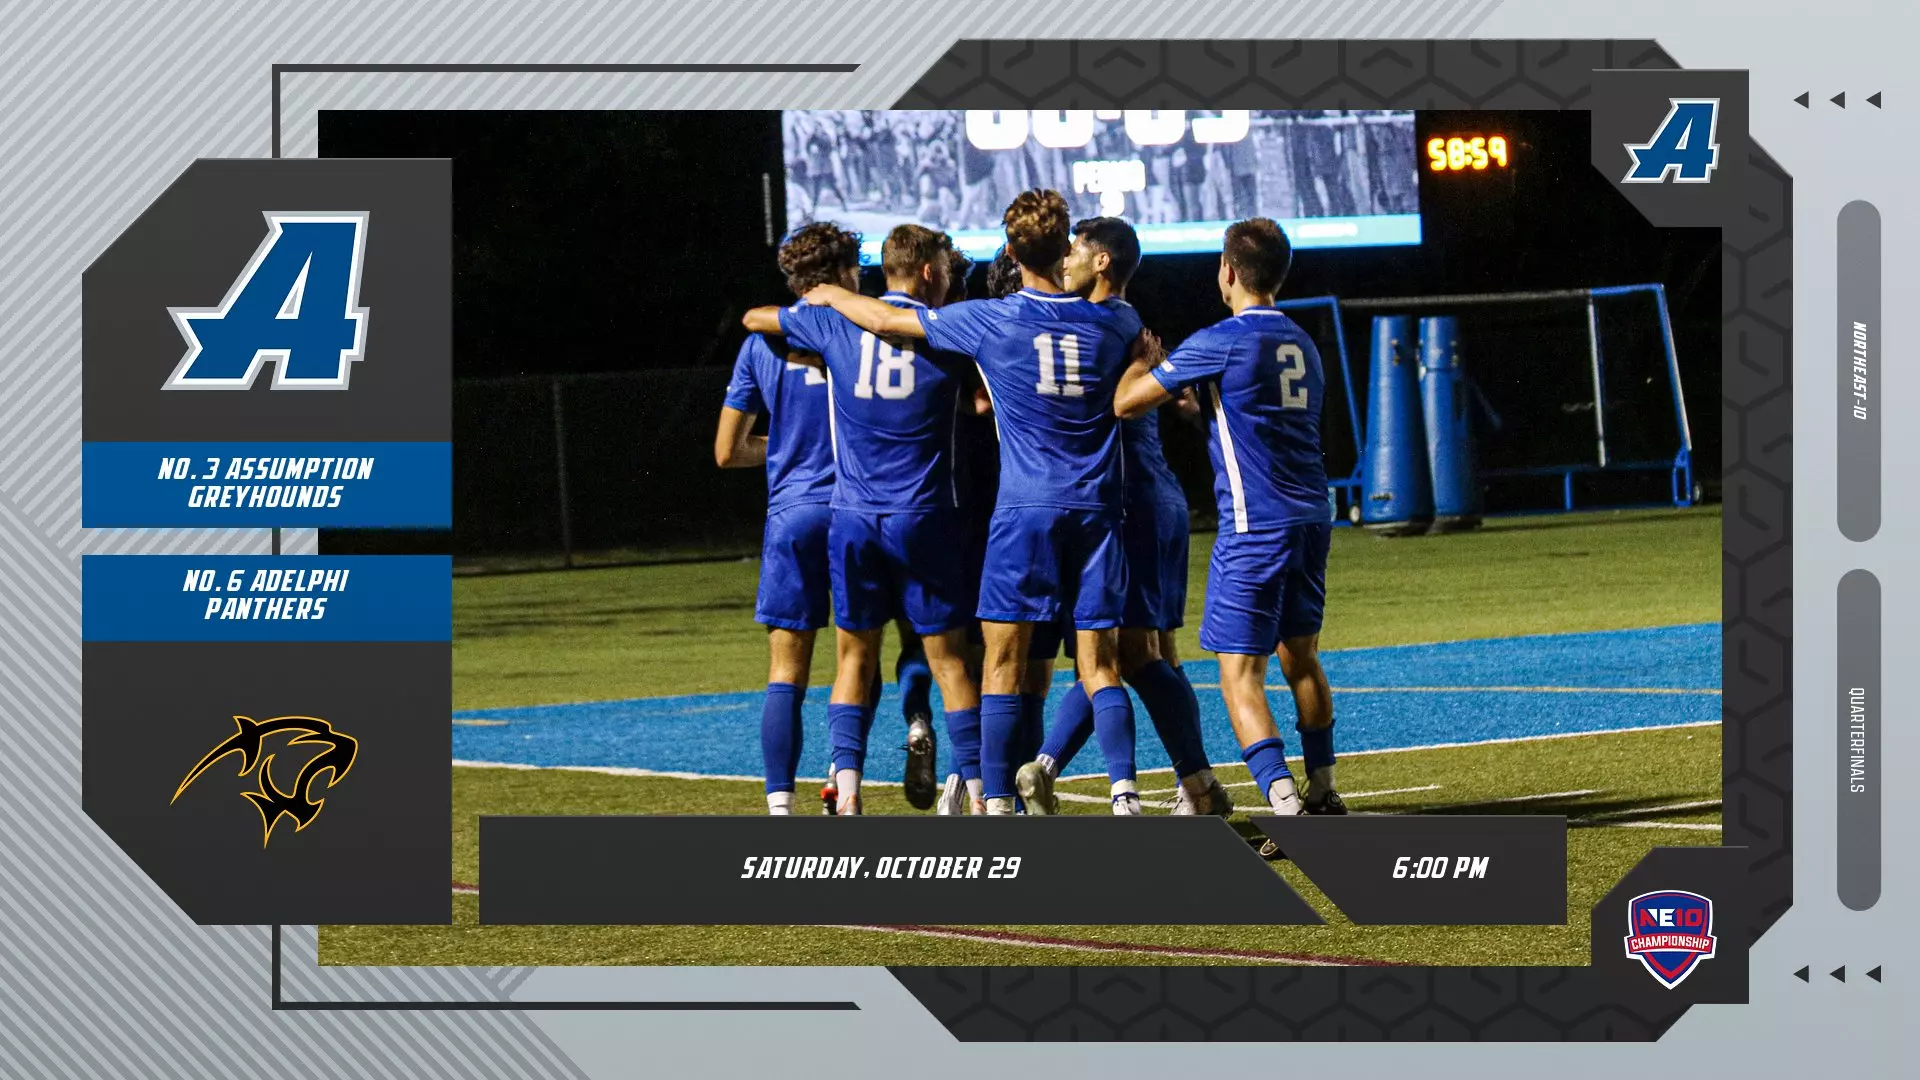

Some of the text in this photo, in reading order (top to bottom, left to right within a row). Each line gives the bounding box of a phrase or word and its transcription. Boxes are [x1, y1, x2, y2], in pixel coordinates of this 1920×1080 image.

[1427, 136, 1507, 171] 58:59
[854, 330, 915, 400] 18
[1033, 333, 1085, 396] 11
[1276, 344, 1308, 409] 2
